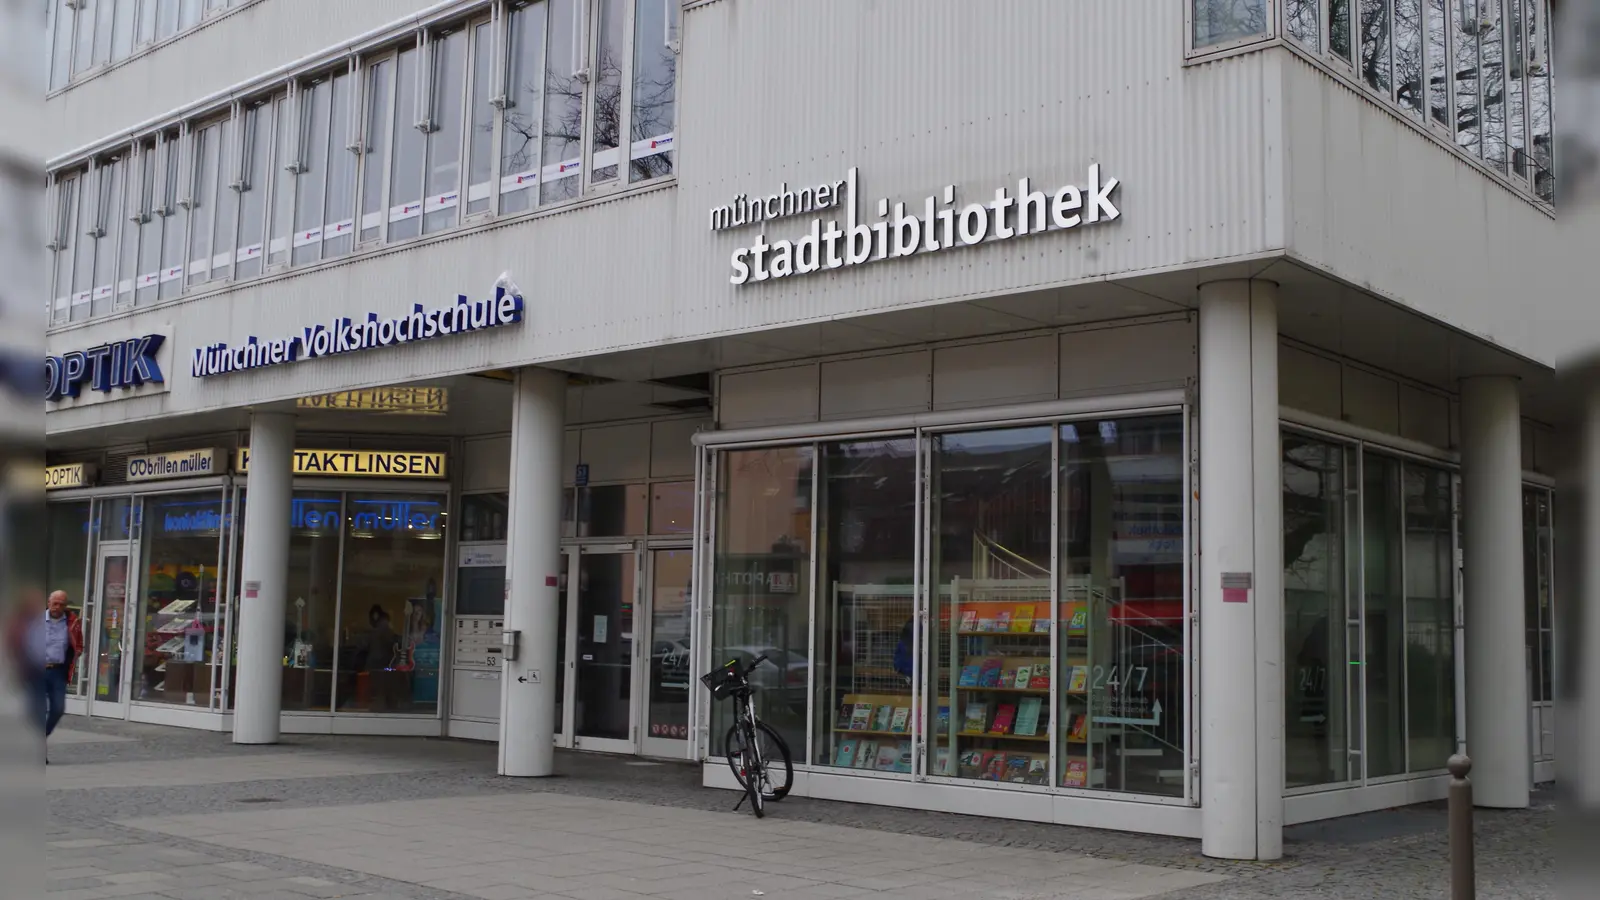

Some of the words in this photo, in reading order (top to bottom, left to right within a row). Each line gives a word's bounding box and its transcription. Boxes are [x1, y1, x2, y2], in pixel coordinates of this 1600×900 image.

[710, 180, 845, 231] münchner
[729, 163, 1120, 285] stadtbibliothek
[192, 336, 298, 378] Münchner
[302, 287, 521, 358] Volkshochschule
[52, 467, 81, 485] OPTIK
[147, 456, 178, 475] brillen
[180, 453, 211, 474] müller
[242, 452, 440, 475] KTAKTLINSEN
[487, 656, 496, 667] 53
[1092, 664, 1148, 693] 24/7
[1299, 665, 1326, 694] 24/7
